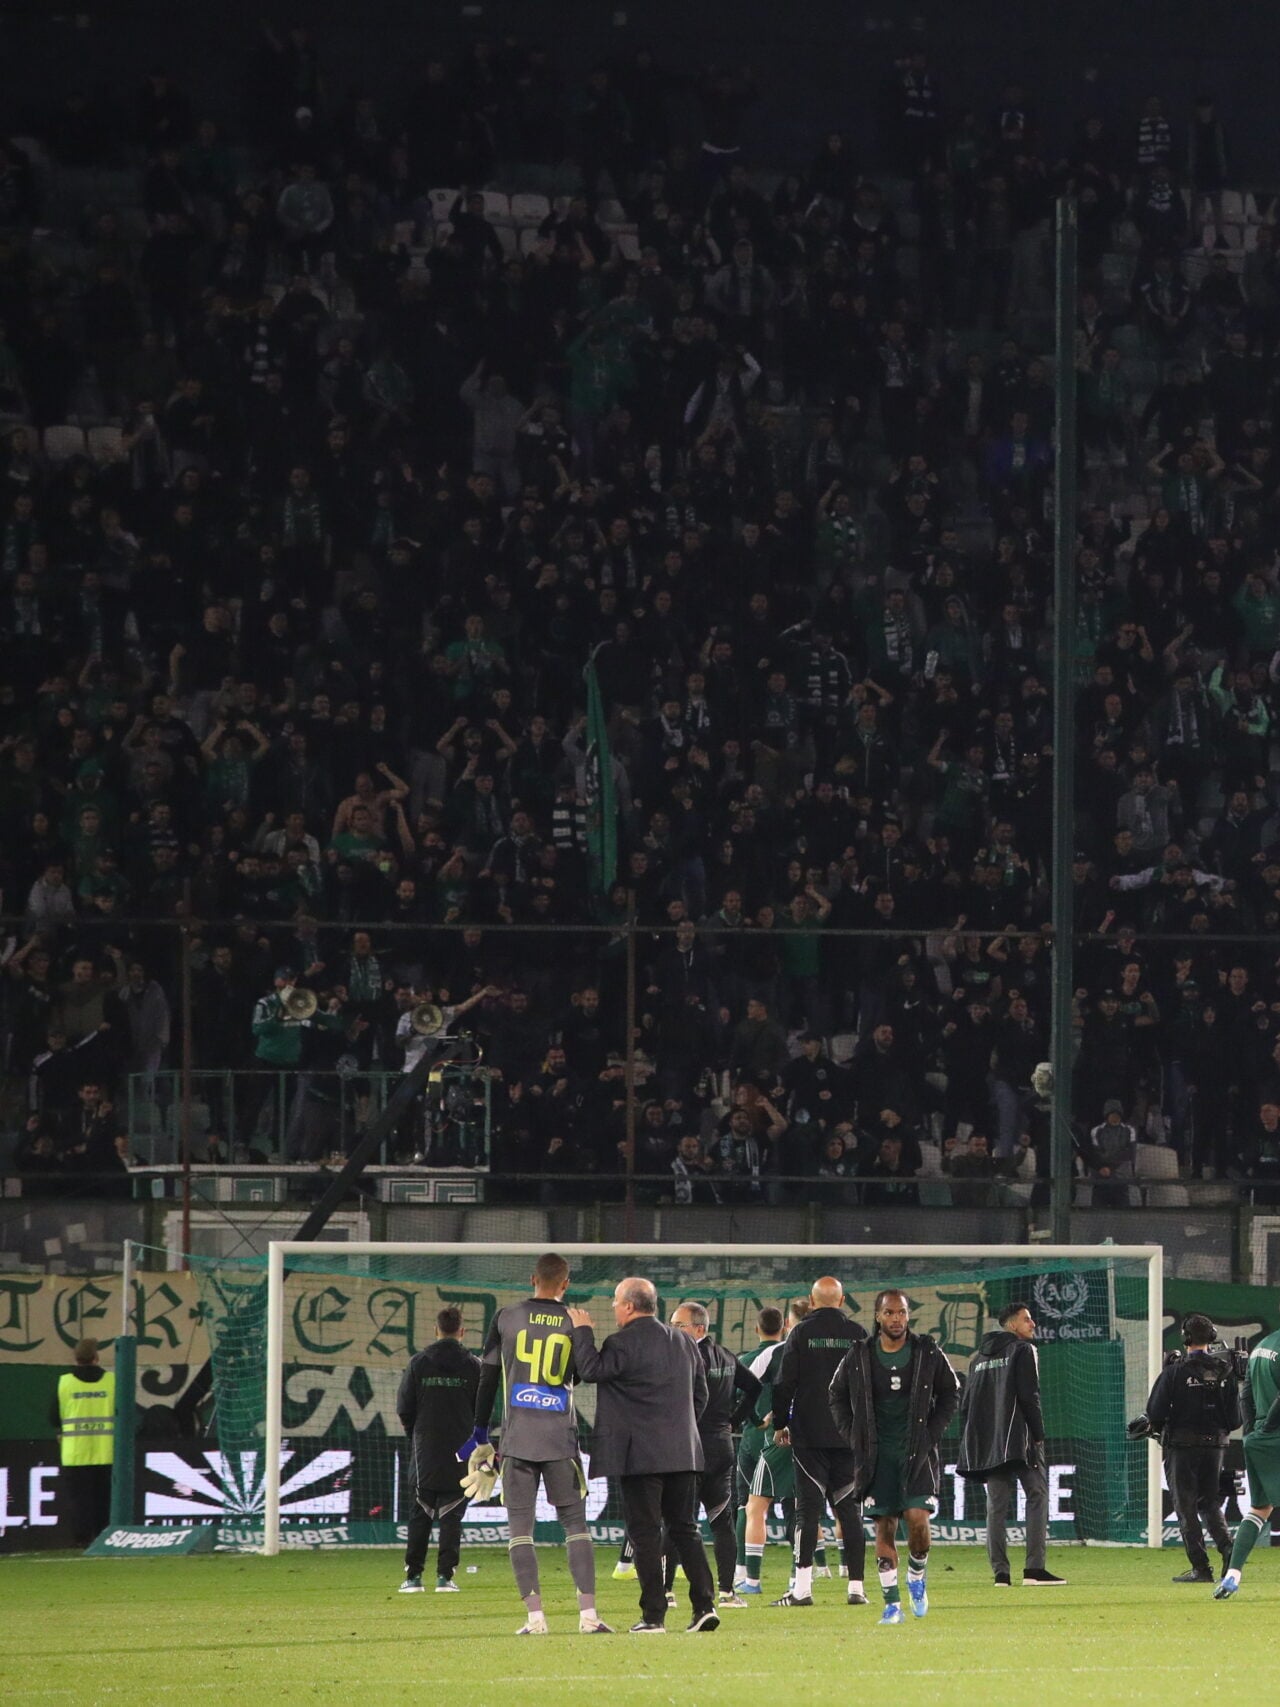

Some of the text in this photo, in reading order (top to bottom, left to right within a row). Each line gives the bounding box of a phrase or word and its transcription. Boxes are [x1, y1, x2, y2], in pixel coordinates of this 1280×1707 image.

[529, 1312, 564, 1327] LAFONT
[515, 1329, 572, 1386] 40
[104, 1529, 193, 1549] SUPERBET
